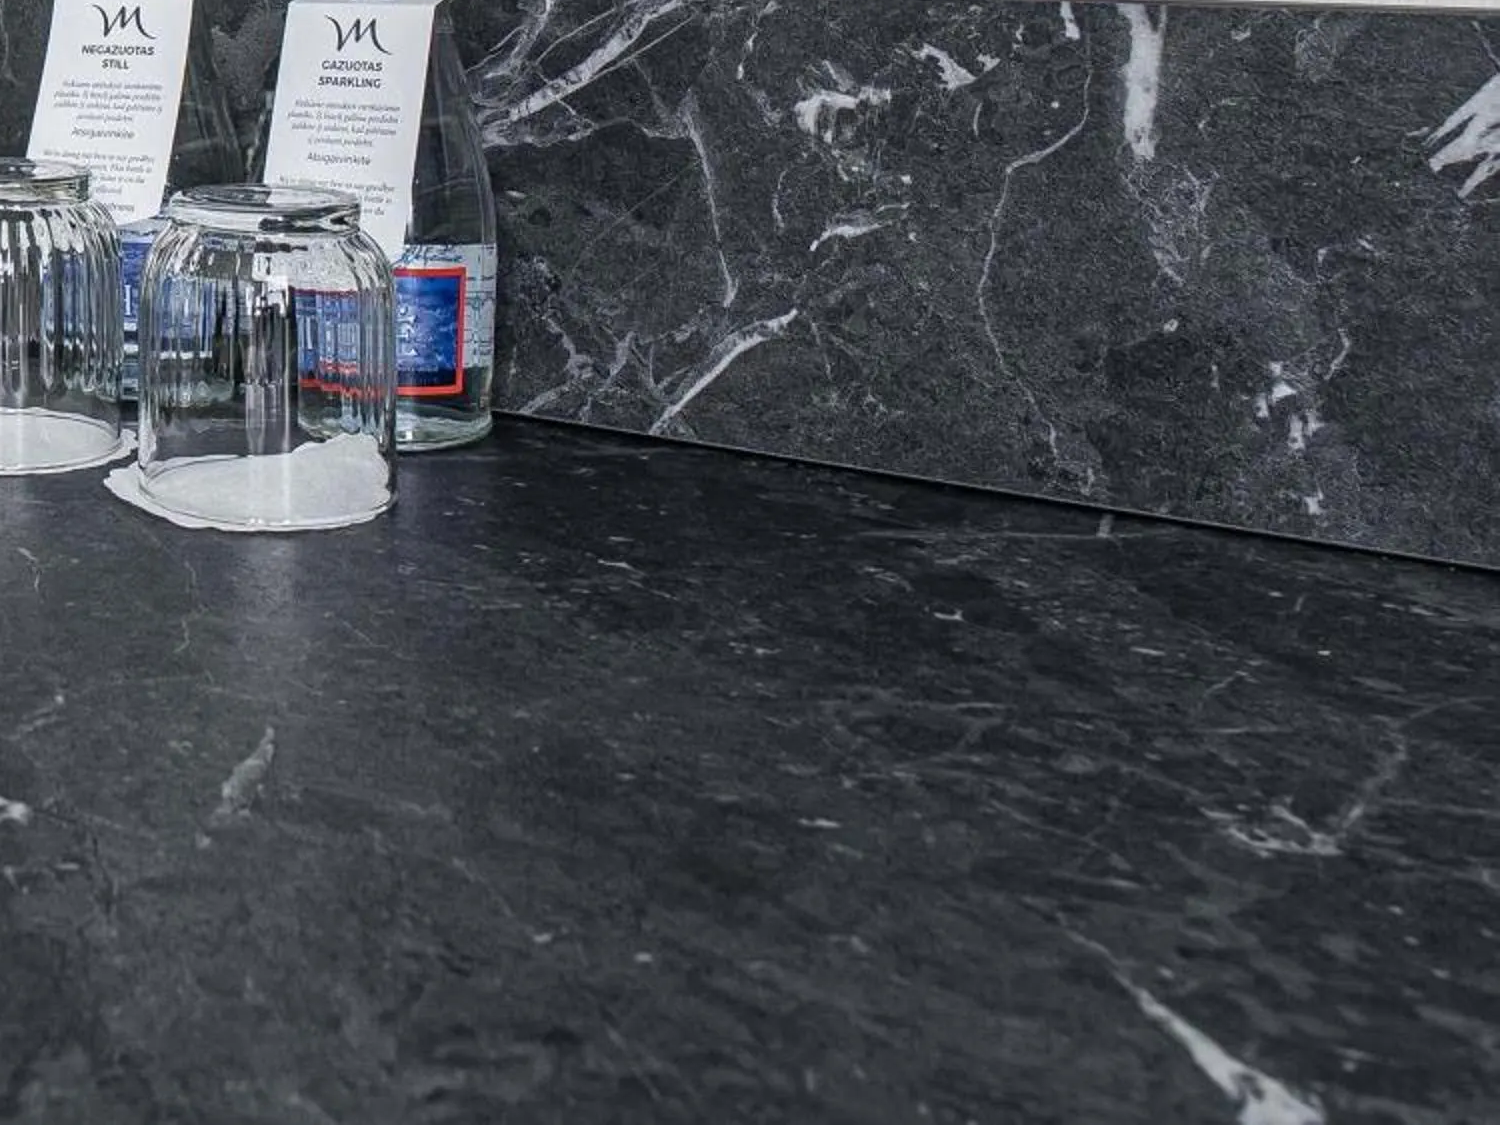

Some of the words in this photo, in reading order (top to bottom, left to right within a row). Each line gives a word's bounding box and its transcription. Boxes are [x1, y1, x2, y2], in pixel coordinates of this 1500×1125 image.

[81, 44, 156, 57] NEGAZUOTAS
[101, 58, 130, 70] STILL
[321, 60, 383, 72] GAZUOTAS
[317, 75, 382, 89] SPARKLING
